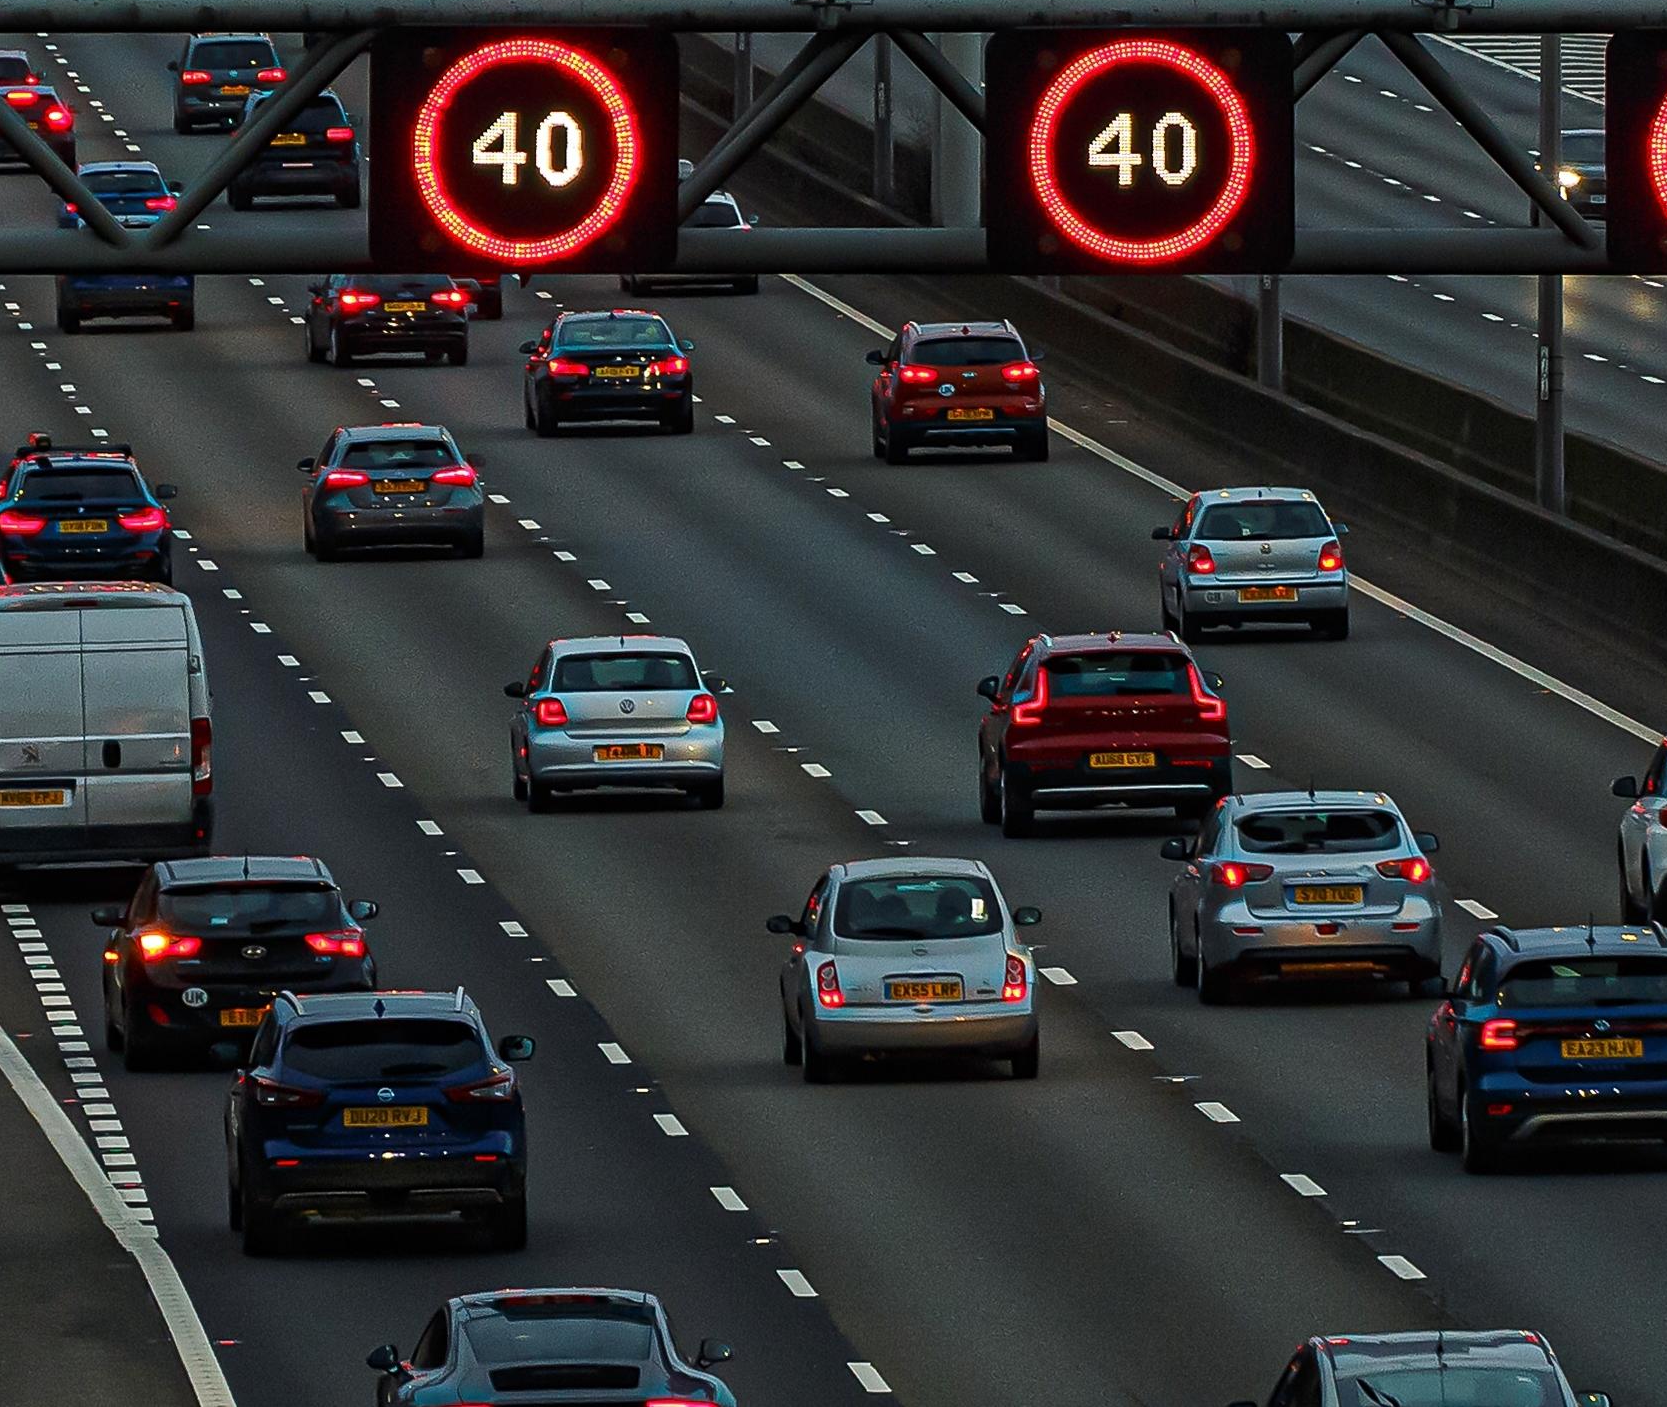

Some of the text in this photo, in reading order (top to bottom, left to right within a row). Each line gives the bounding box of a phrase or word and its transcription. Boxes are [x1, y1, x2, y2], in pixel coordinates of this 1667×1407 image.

[472, 111, 584, 187] 40
[1088, 111, 1197, 187] 40
[893, 982, 962, 998] EX55 LRF
[186, 994, 207, 1005] UK
[350, 1109, 388, 1124] DU20
